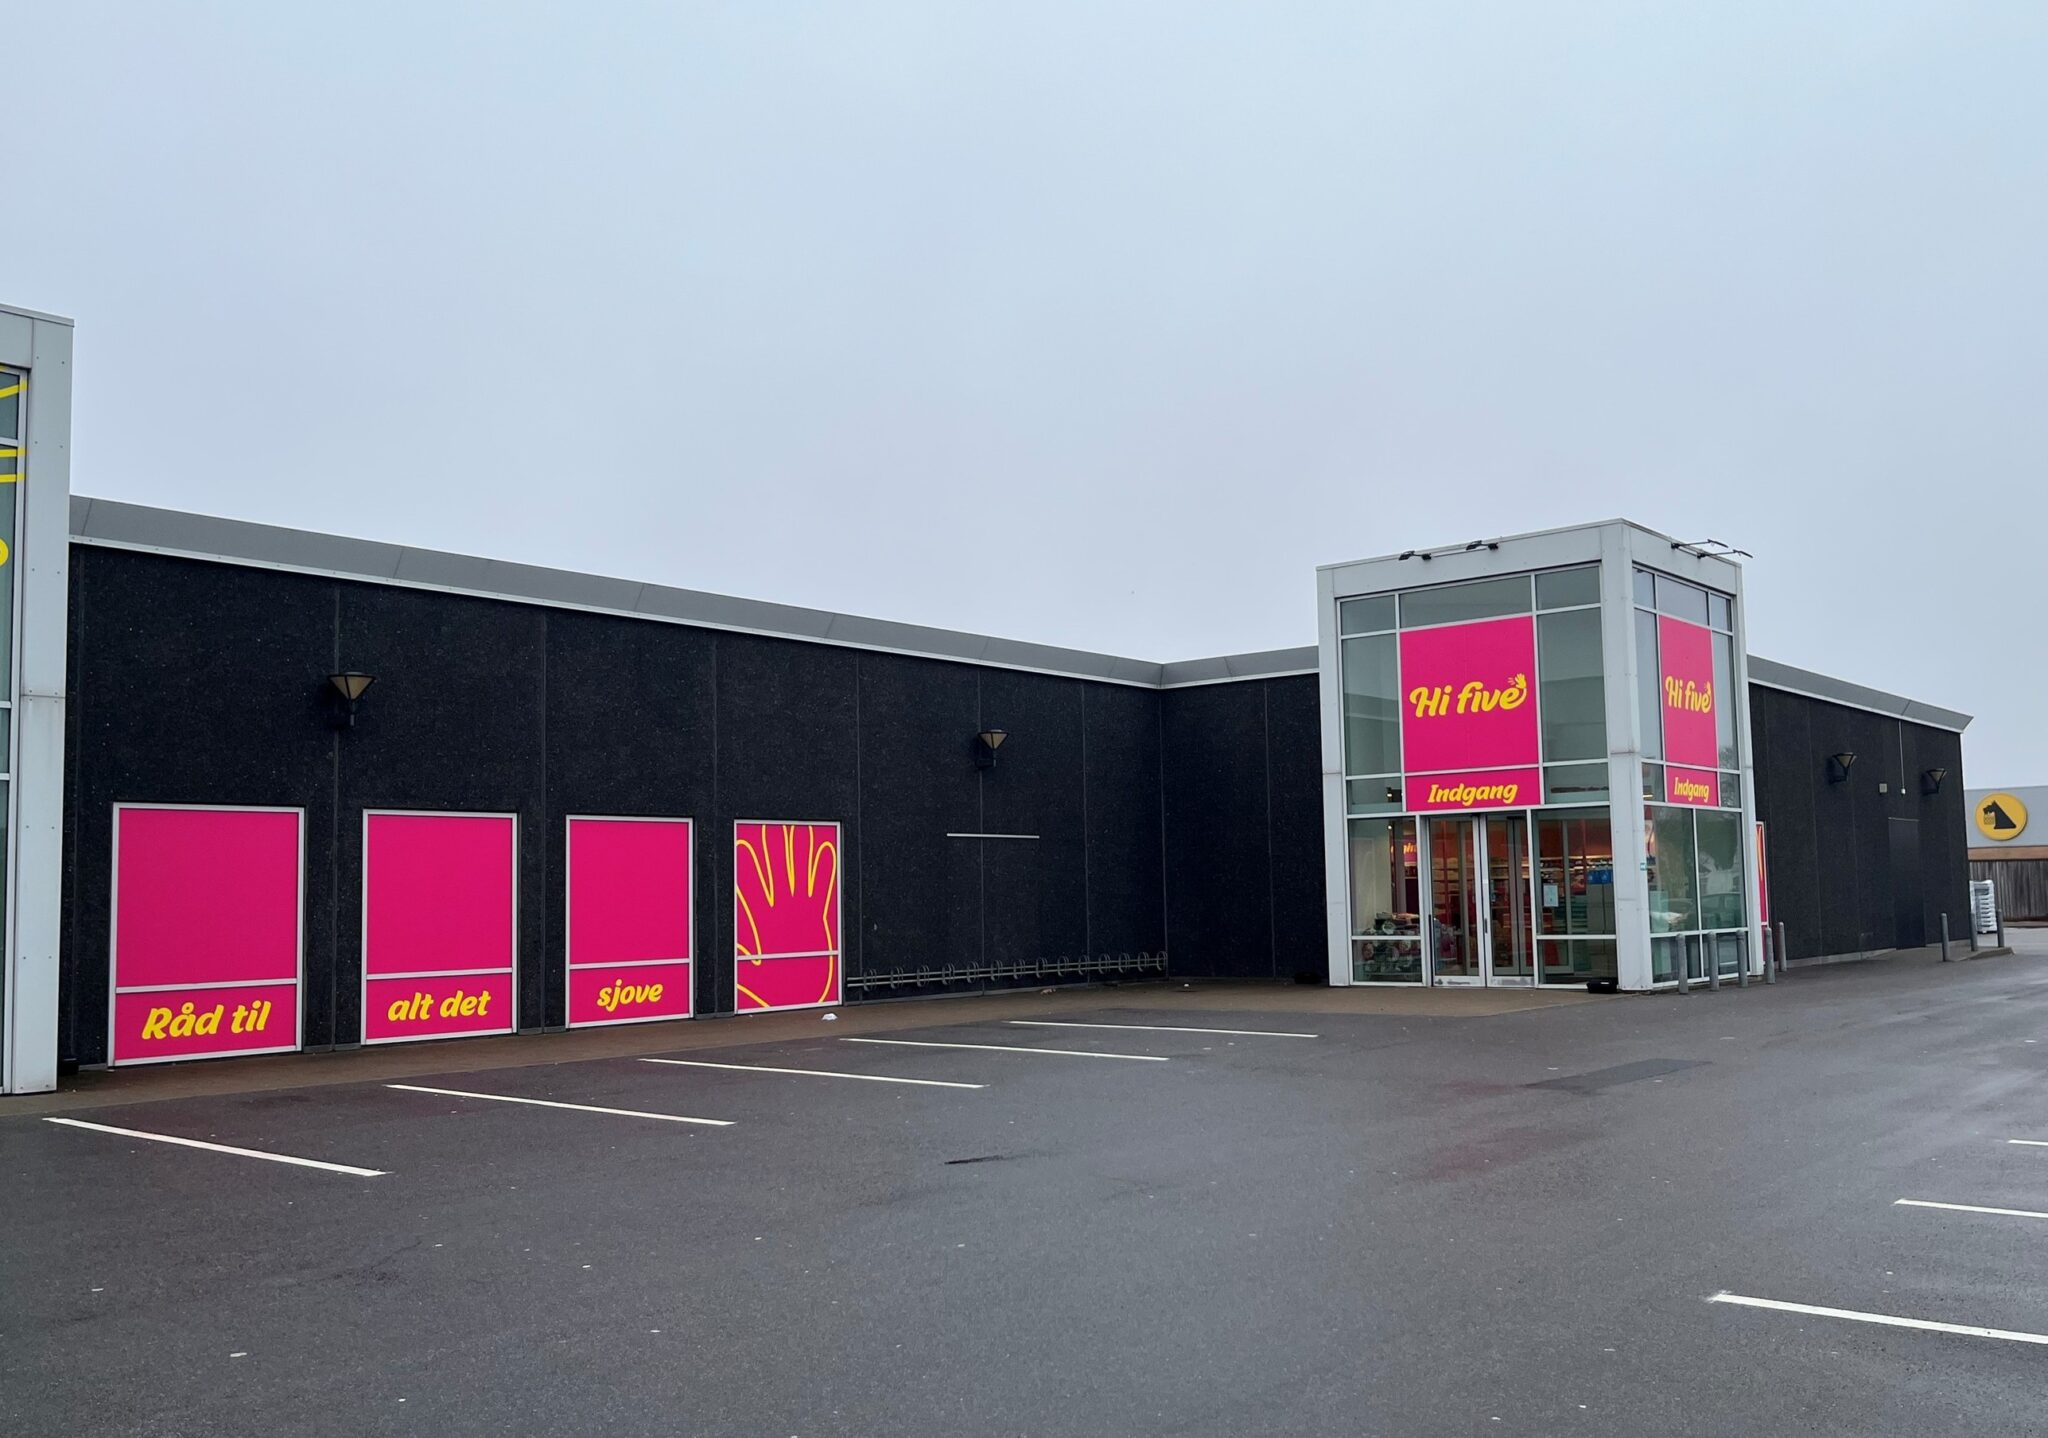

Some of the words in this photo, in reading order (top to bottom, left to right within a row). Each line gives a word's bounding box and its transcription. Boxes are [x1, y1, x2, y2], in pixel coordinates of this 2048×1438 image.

[1409, 685, 1453, 717] Hi
[1456, 677, 1527, 714] five
[1665, 676, 1684, 708] Hi
[1684, 680, 1712, 714] five
[1428, 783, 1519, 806] Indgang
[1674, 777, 1710, 802] Indgang
[387, 992, 435, 1022] alt
[439, 990, 492, 1019] det
[596, 979, 664, 1013] sjove
[140, 1001, 225, 1041] Råd
[230, 1000, 273, 1035] til
